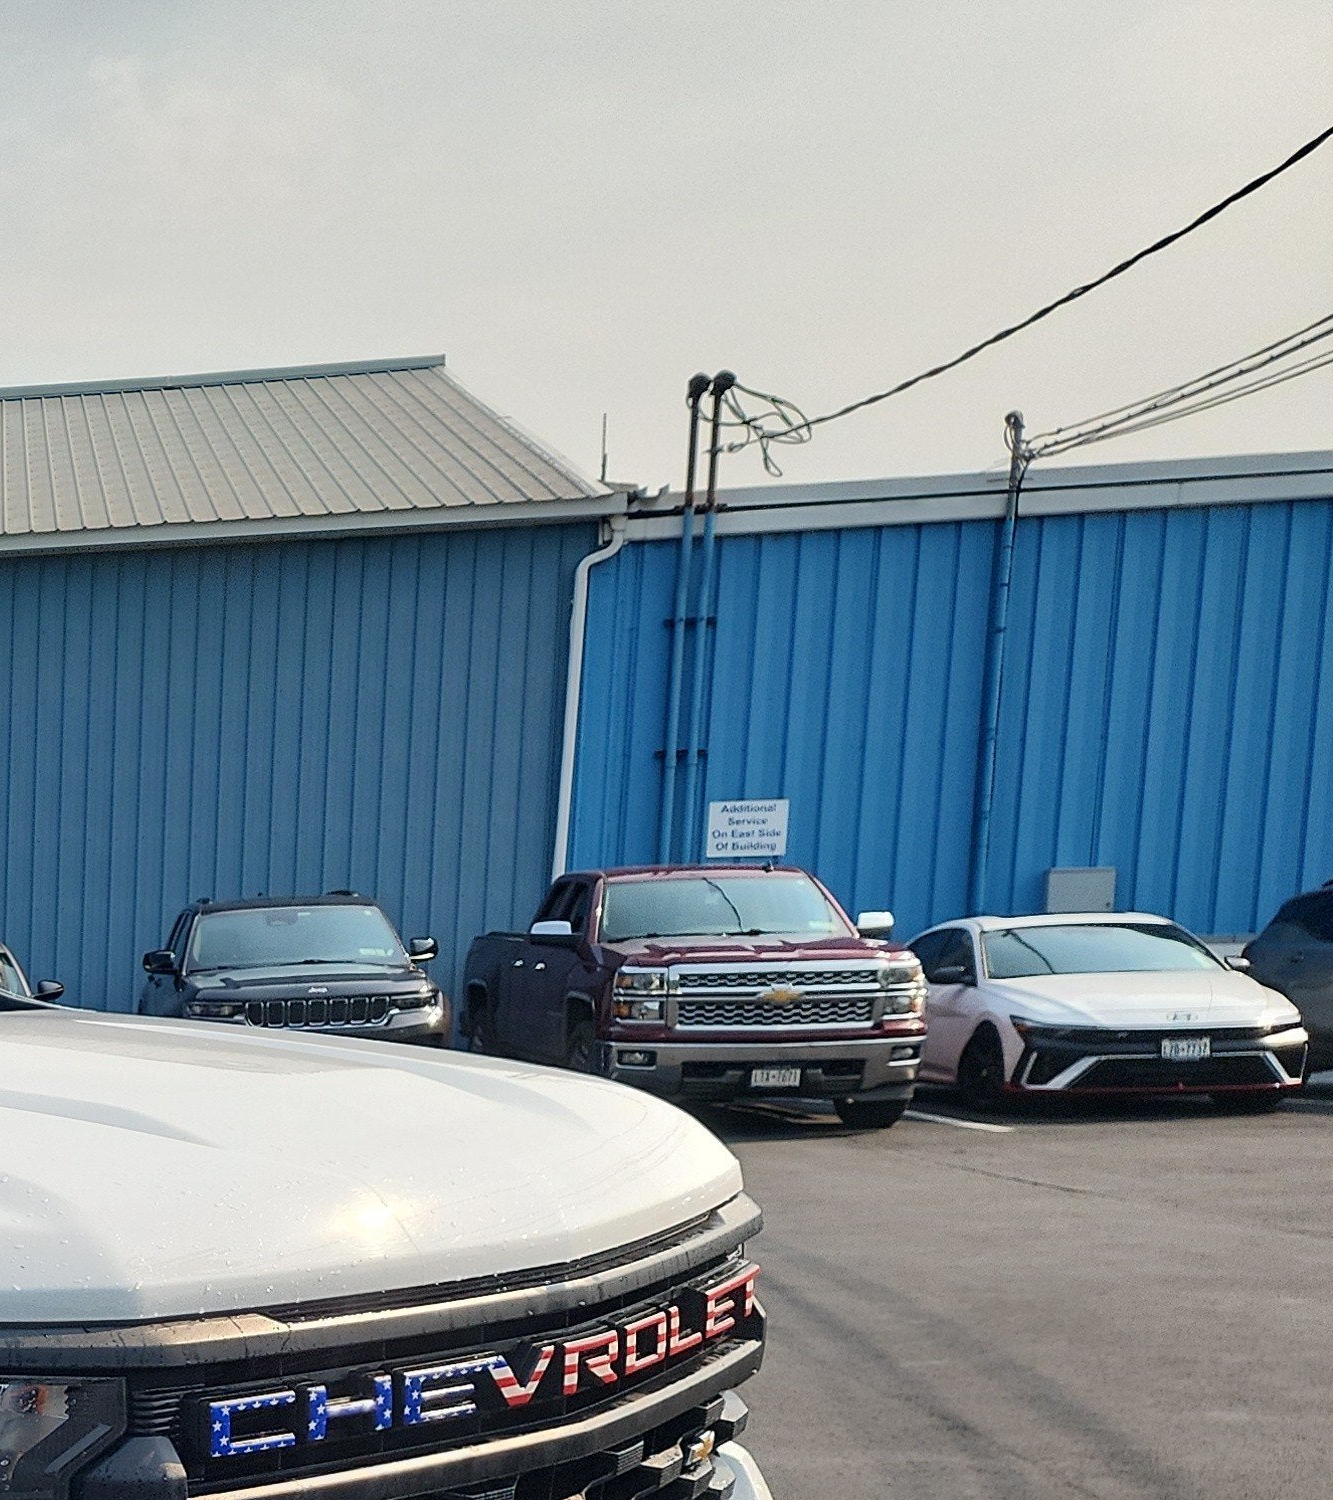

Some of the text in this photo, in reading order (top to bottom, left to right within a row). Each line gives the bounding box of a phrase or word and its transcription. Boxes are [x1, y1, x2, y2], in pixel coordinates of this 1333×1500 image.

[721, 803, 777, 813] Additional
[727, 817, 769, 826] Service
[712, 828, 782, 839] On East Side
[715, 841, 777, 852] Of Building
[209, 1263, 762, 1458] CHEVROLET
